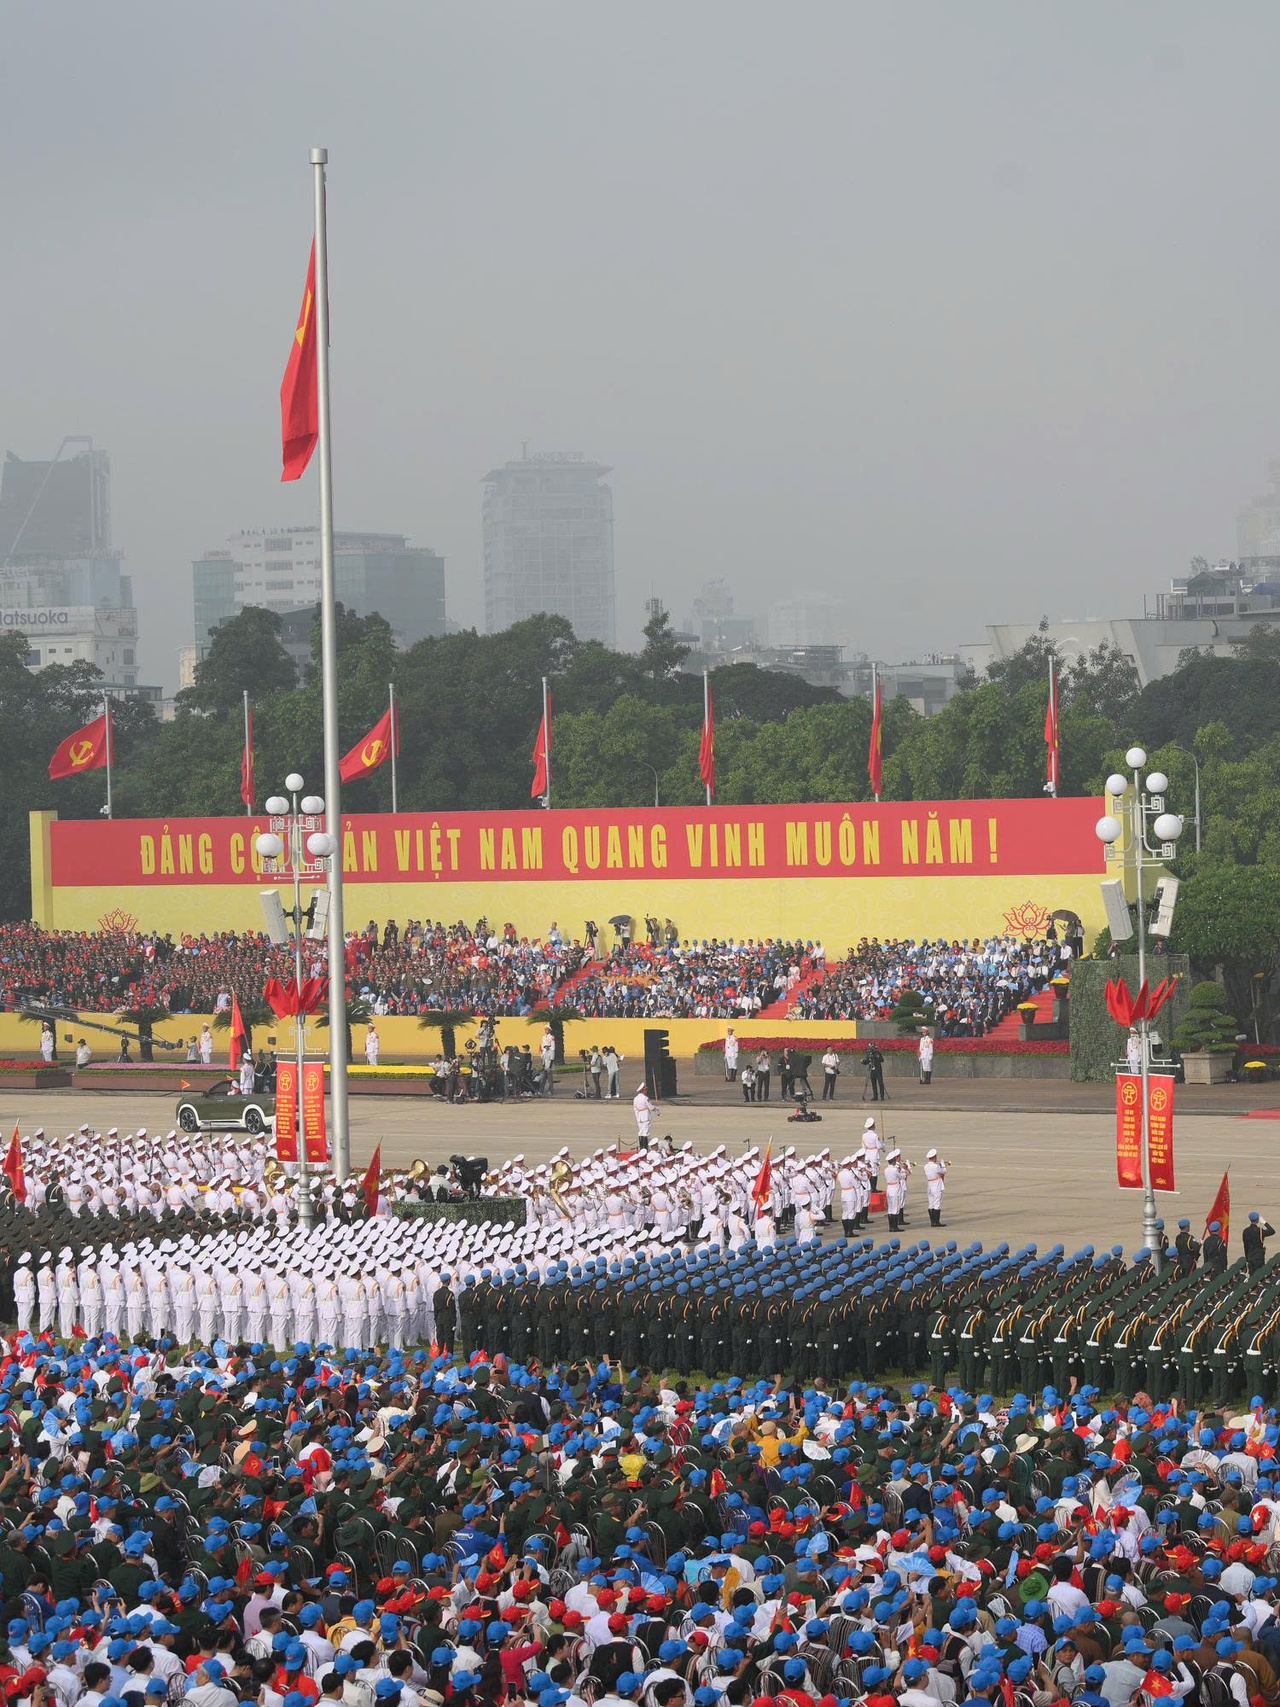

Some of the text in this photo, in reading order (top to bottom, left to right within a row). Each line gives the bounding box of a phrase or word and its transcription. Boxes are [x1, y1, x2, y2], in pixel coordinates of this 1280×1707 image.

[140, 825, 214, 875] ĐẢNG
[395, 821, 462, 879] VIỆT
[480, 828, 543, 871] NAM
[563, 826, 668, 874] QUANG
[686, 823, 765, 867] VINH
[786, 813, 881, 866] MUÔN
[901, 811, 973, 865] NĂM
